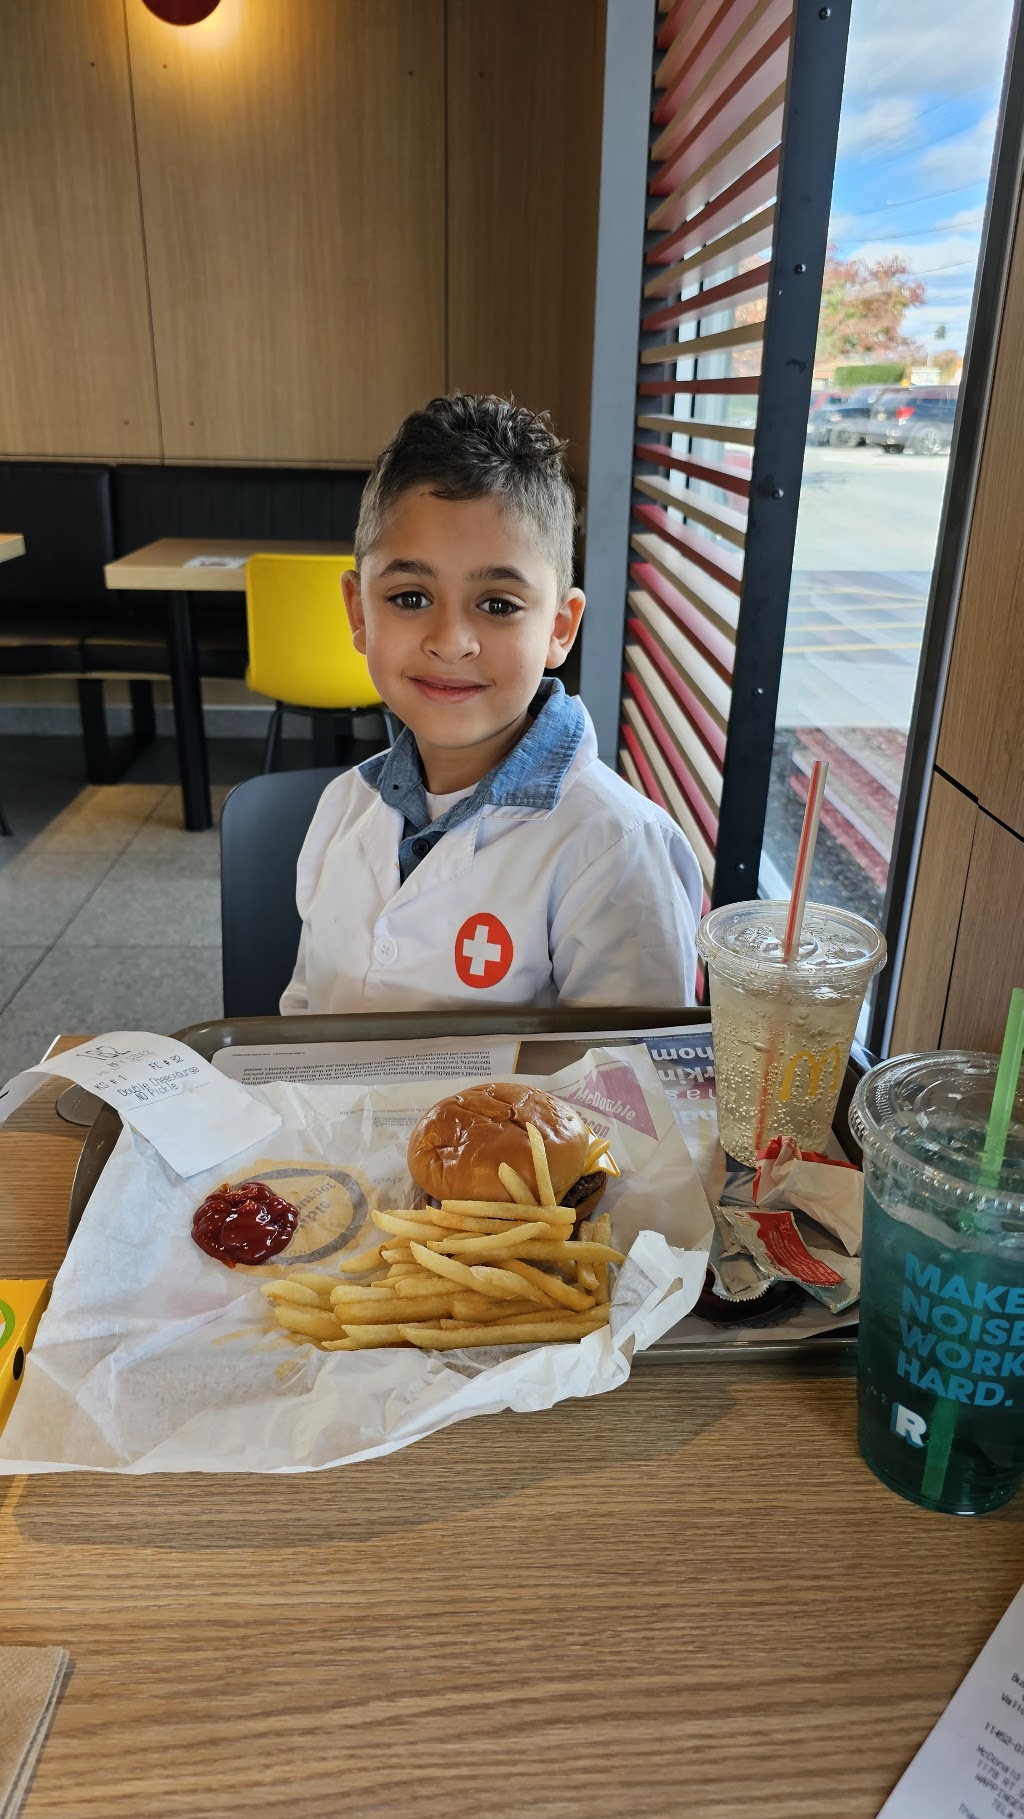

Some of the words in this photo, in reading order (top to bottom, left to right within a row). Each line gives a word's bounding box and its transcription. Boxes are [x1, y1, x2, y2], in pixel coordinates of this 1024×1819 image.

[117, 1082, 150, 1097] Double
[573, 1087, 636, 1121] McDouble
[904, 1252, 1024, 1315] MAKE
[902, 1285, 1024, 1347] NOISE
[900, 1316, 1024, 1377] WORK
[896, 1349, 1013, 1407] HARD.
[890, 1401, 928, 1449] R
